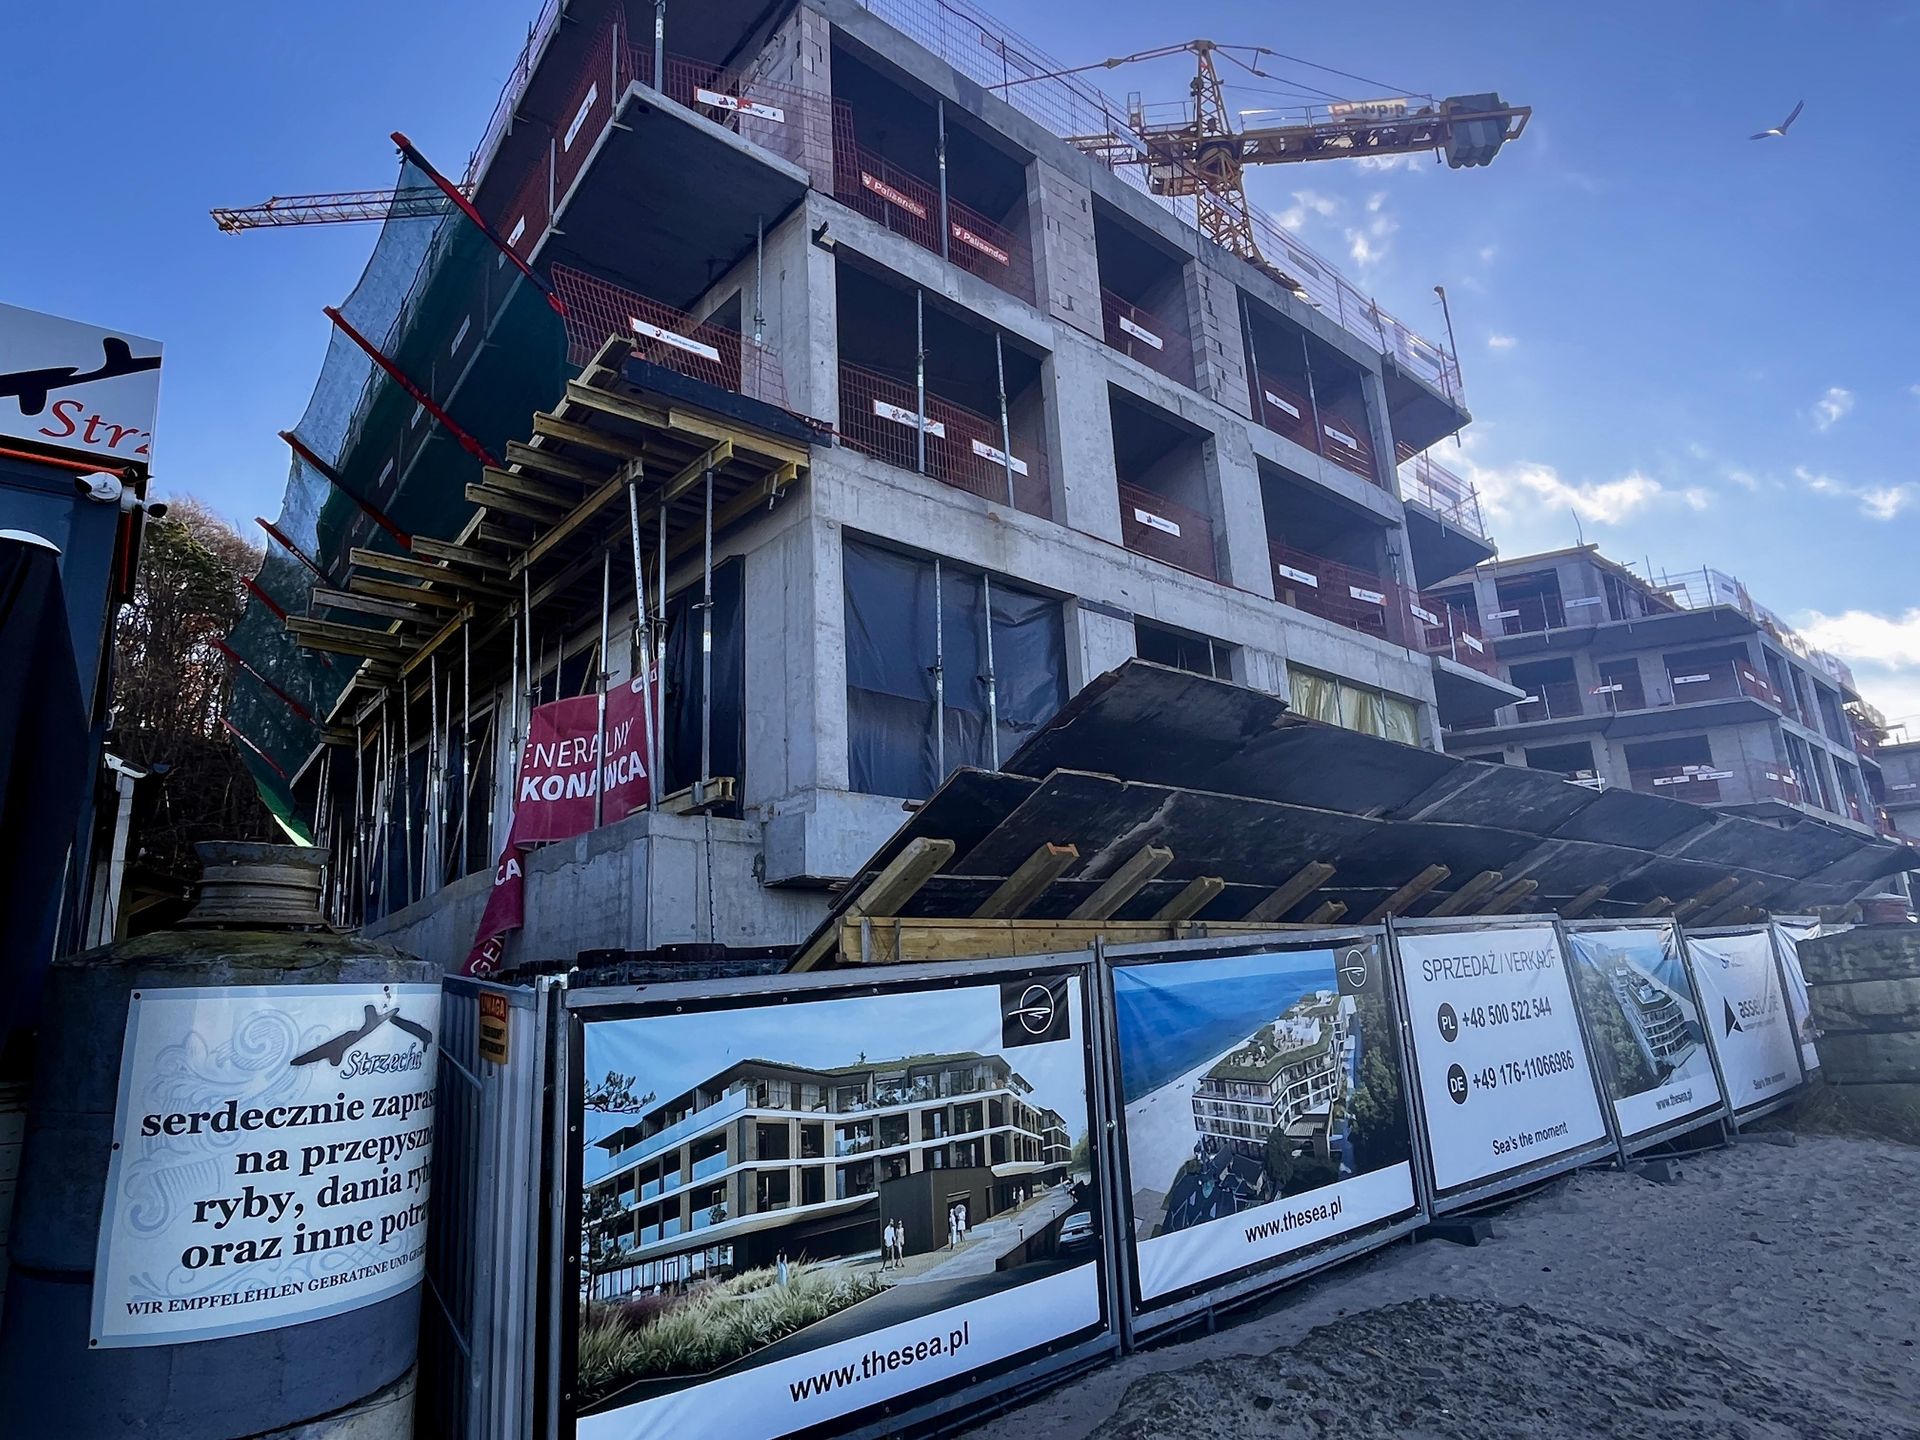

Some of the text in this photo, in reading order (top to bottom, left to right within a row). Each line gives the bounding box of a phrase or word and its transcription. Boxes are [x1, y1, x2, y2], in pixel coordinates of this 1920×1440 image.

[874, 181, 925, 216] Palisander
[963, 232, 1008, 263] Palisander
[1422, 950, 1498, 982] SPRZEDAŻ
[1505, 948, 1556, 973] VERKAUF
[1441, 996, 1552, 1031] PL +48 500 522 544
[340, 1042, 423, 1080] Strzecha
[1450, 1050, 1575, 1093] DE +49 176-11066986
[141, 1092, 365, 1138] serdecznie
[1492, 1121, 1569, 1155] Sea's the moment
[235, 1148, 289, 1176] na
[192, 1185, 305, 1230] ryby,
[316, 1168, 402, 1210] dania
[1244, 1195, 1342, 1243] www.thesea.pl
[181, 1234, 283, 1270] oraz
[292, 1223, 373, 1256] inne
[126, 1301, 163, 1316] WIR
[168, 1281, 304, 1313] EMPFELEHLEN
[308, 1262, 388, 1292] GEBRATENE
[390, 1255, 408, 1270] UND
[789, 1319, 970, 1403] www.thesea.pl
